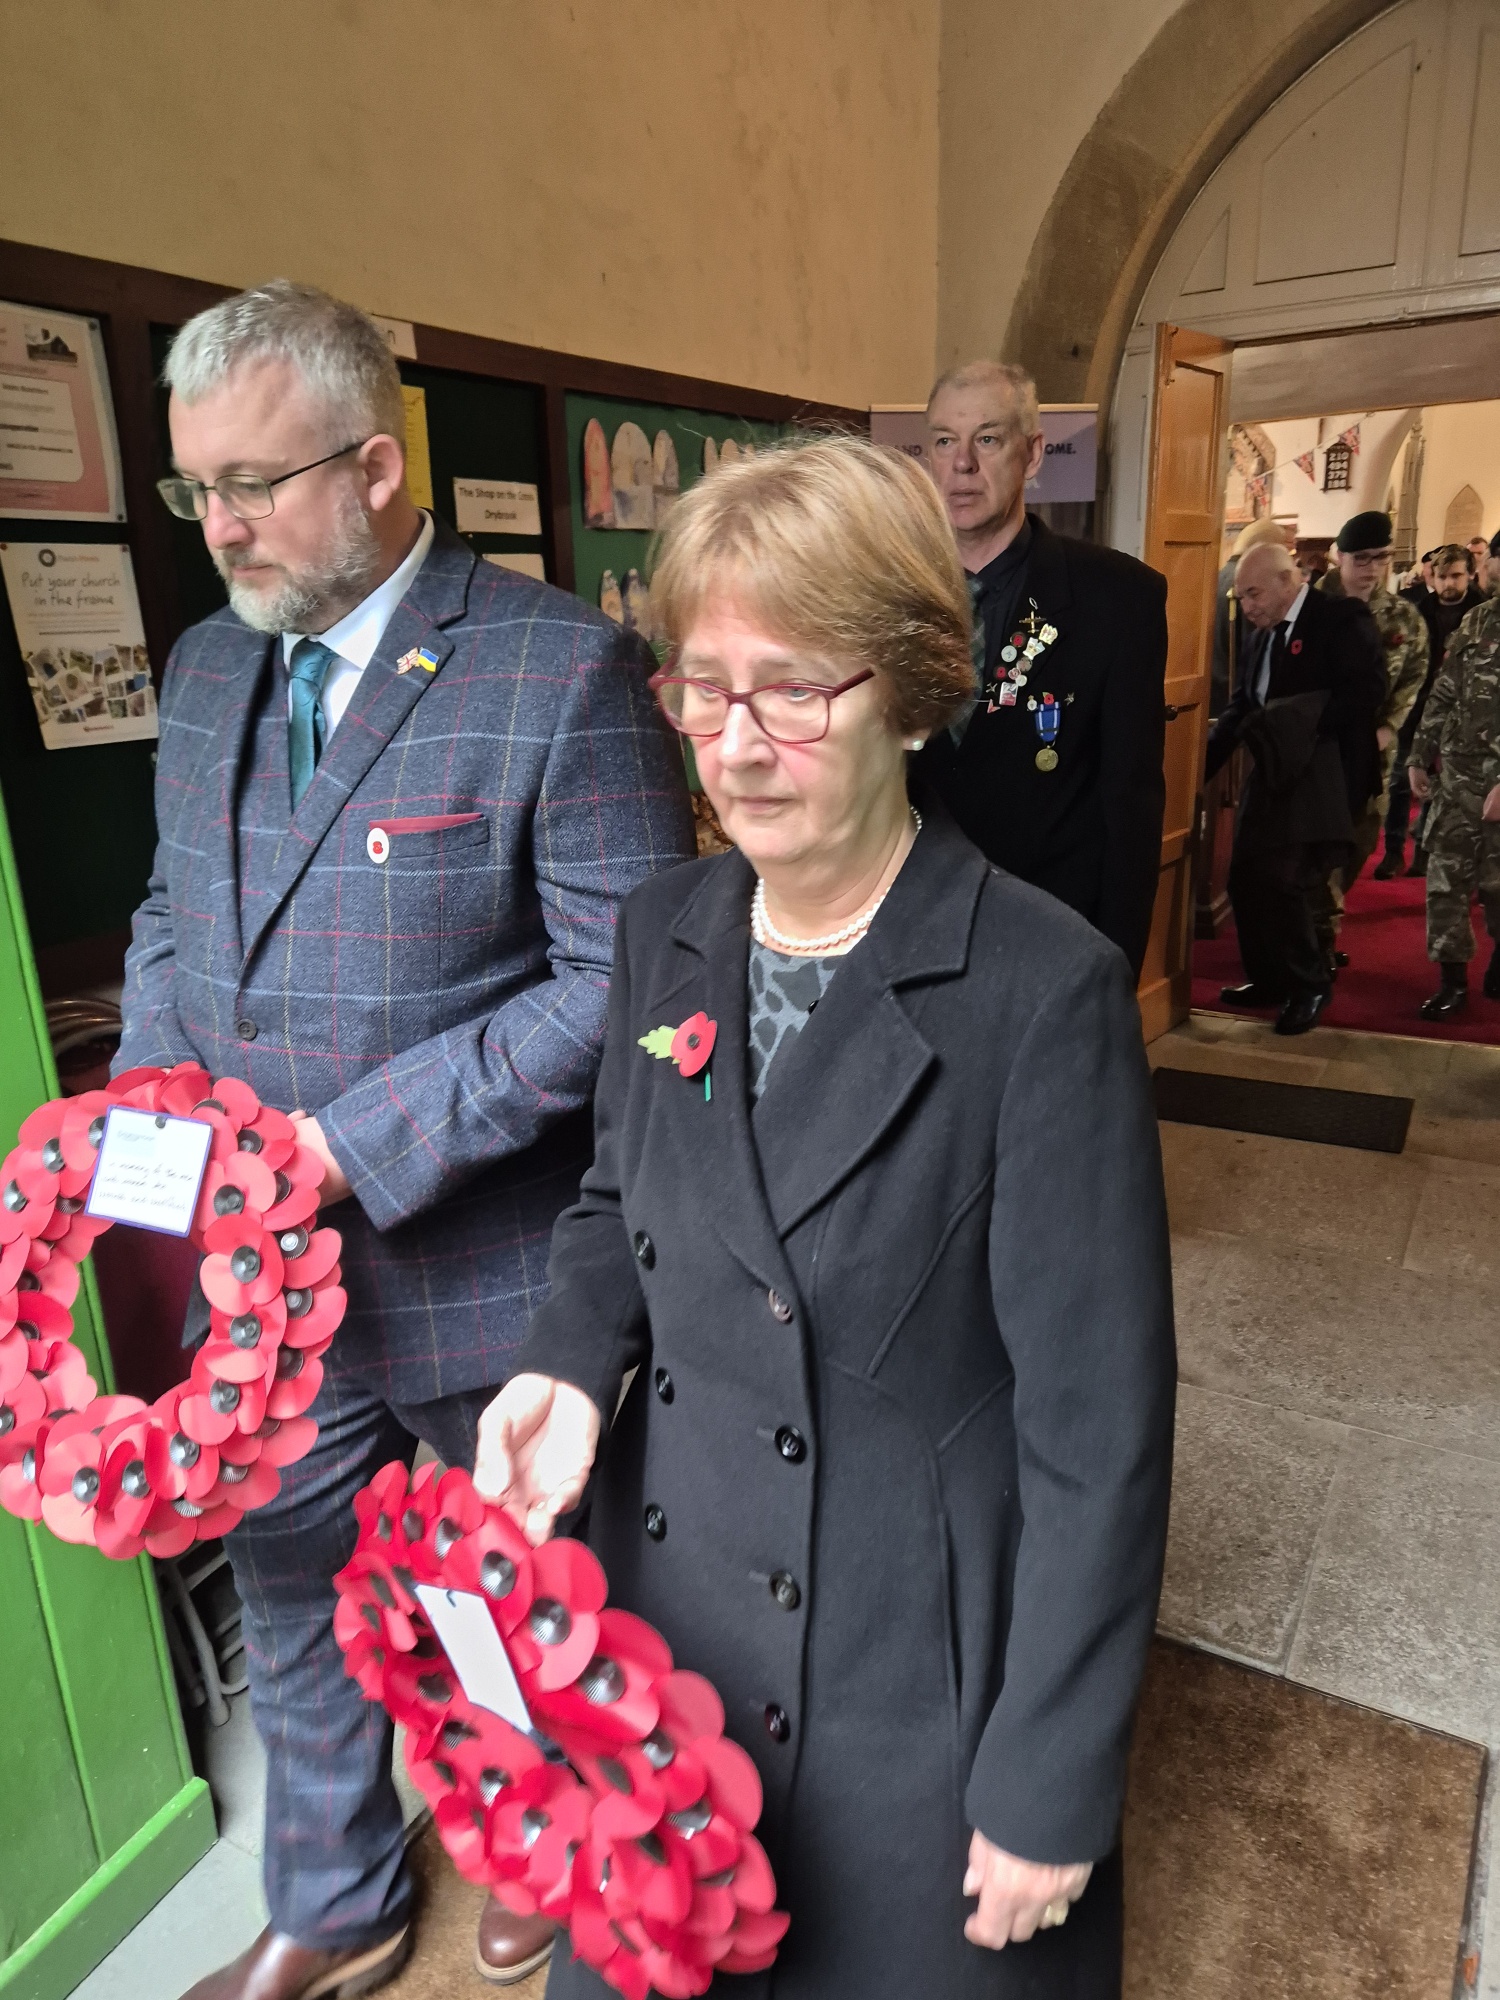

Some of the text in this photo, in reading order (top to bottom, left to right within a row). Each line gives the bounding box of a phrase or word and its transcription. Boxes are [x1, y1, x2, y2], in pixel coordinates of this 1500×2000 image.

[1045, 443, 1076, 455] OME.
[21, 571, 120, 592] Put your church
[34, 589, 114, 609] in the frame
